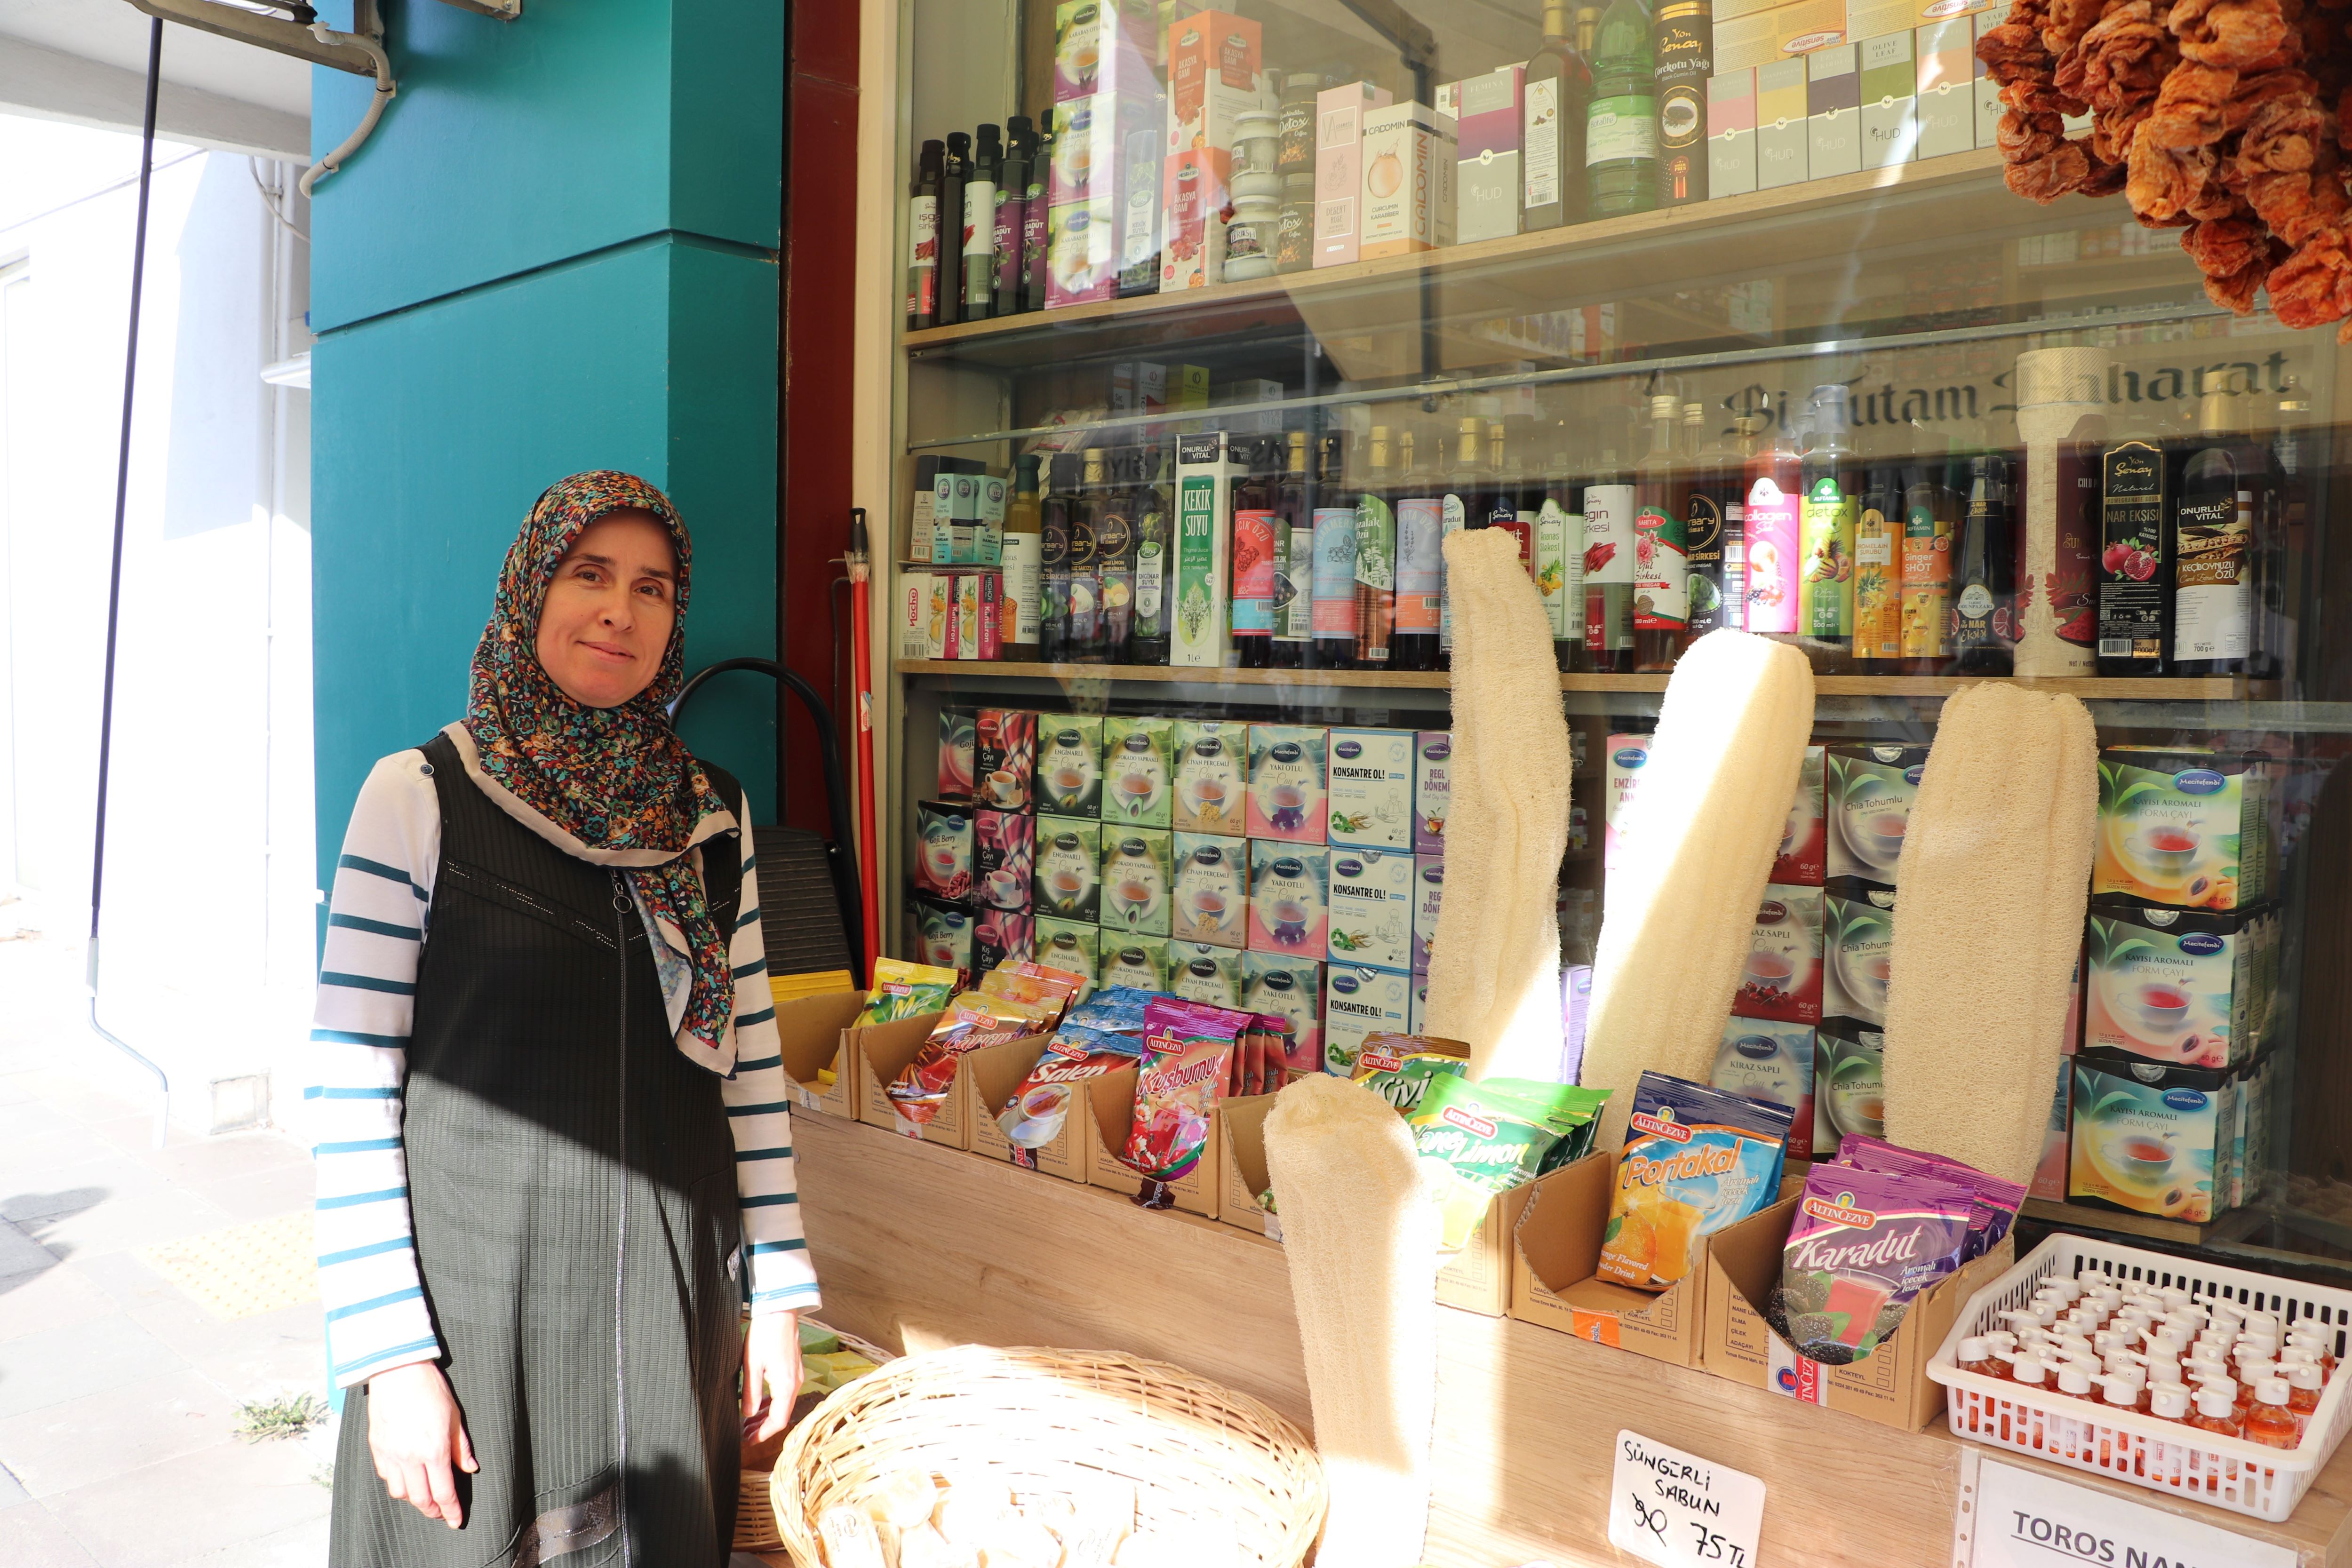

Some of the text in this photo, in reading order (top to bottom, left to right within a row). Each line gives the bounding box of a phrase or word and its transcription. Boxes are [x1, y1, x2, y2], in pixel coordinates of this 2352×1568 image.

[1986, 11, 2009, 21] YABA
[1872, 40, 1898, 51] OLIVE
[1224, 47, 1244, 59] AKASYA
[1875, 48, 1896, 57] LEAF
[1178, 55, 1197, 70] AKASYA
[1689, 58, 1710, 70] Yağı
[1178, 69, 1190, 80] GAMI
[1469, 79, 1504, 94] FEMINA
[1990, 103, 2007, 116] HU
[1369, 120, 1405, 135] CADOMIN
[1932, 115, 1958, 129] HUD
[1875, 127, 1901, 142] HUD
[1821, 137, 1845, 151] HUD
[1770, 148, 1794, 162] HUD
[1719, 159, 1740, 171] HUD
[1415, 133, 1427, 236] CADOMIN
[1174, 191, 1196, 203] AKASYA
[1476, 185, 1502, 202] HUD
[1174, 203, 1188, 214] GAMI
[1326, 205, 1347, 216] DESERT
[1372, 203, 1398, 213] CURCUMIN
[1330, 215, 1343, 224] ROSE
[1371, 210, 1399, 221] KARABİBER
[1192, 450, 1211, 459] VİTAL
[2114, 462, 2153, 477] Şenay
[2078, 478, 2092, 488] COLD
[1184, 485, 1211, 511] KEKİK
[1807, 506, 1848, 518] detox
[2180, 504, 2221, 515] ONURLU
[1745, 509, 1792, 525] collagen
[2106, 510, 2126, 523] NAR
[2195, 511, 2224, 521] VİTAL
[1185, 515, 1208, 537] SUYU
[1540, 532, 1559, 541] Ananas
[2138, 532, 2158, 541] KATKISIZ
[1695, 550, 1720, 560] SİRKESİ
[1905, 553, 1933, 562] Ginger
[1638, 560, 1654, 571] Gül
[1905, 563, 1932, 572] SHOT
[2182, 561, 2234, 573] KEÇİBOYNUZU
[1635, 572, 1661, 581] Sirkesi
[2214, 568, 2235, 579] ÖZÜ
[1969, 620, 1985, 629] NAR
[982, 743, 991, 754] Kış
[1054, 748, 1084, 757] ENGİNARLI
[982, 752, 994, 762] Çayı
[1187, 758, 1230, 768] CİVAN PERÇEMLİ
[1333, 766, 1385, 780] KONSANTRE OL!
[1429, 769, 1445, 779] REGL
[2179, 778, 2221, 788] Mecitefendi
[1845, 796, 1903, 812] Chia Tohumlu
[2133, 797, 2202, 808] KAYISI AROMALI
[2139, 809, 2193, 820] FORM ÇAYI
[929, 835, 956, 844] Goji Berry
[1052, 851, 1081, 860] ENGİNARLI
[1333, 883, 1386, 899] KONSANTRE OL!
[2125, 953, 2194, 967] KAYISI AROMALI
[2132, 965, 2185, 978] FORM ÇAYI
[961, 1011, 997, 1028] ALTINCEZVE
[1050, 1043, 1087, 1059] ALTINCEZVE
[1149, 1040, 1182, 1052] ALTINCEZVE
[1362, 1056, 1400, 1070] ALTINCEZVE
[1730, 1060, 1780, 1074] KİRAZ SAPLI
[1139, 1056, 1218, 1098] Kuşburnu
[2167, 1095, 2205, 1105] Mecitefendi
[2110, 1105, 2178, 1121] KAYISI AROMALI
[1445, 1108, 1493, 1136] ALTINCEZVE
[1635, 1115, 1688, 1139] ALTINCEZVE
[2116, 1117, 2168, 1131] FORM ÇAYI
[1622, 1137, 1743, 1189] Portakal
[1721, 1174, 1760, 1187] Aromalı
[1721, 1185, 1750, 1196] içecek
[1721, 1196, 1742, 1207] tozu
[1808, 1202, 1871, 1226] ALTINCEZVE
[1793, 1225, 1922, 1271] Karadut
[1617, 1253, 1649, 1271] Flavored
[1614, 1265, 1636, 1280] Drink
[1900, 1261, 1936, 1276] Aromalı
[1901, 1274, 1928, 1285] içecek
[1902, 1283, 1922, 1293] tozu
[1732, 1305, 1747, 1314] NANE
[1731, 1328, 1747, 1337] ÇİLEK
[1730, 1339, 1754, 1350] ADAÇAYI
[1839, 1369, 1866, 1381] KOKTEYL
[1624, 1440, 1711, 1491] SÜNGERLİ
[1655, 1479, 1721, 1517] SABUN
[1690, 1522, 1727, 1559] 75
[2012, 1509, 2116, 1563] TOROS
